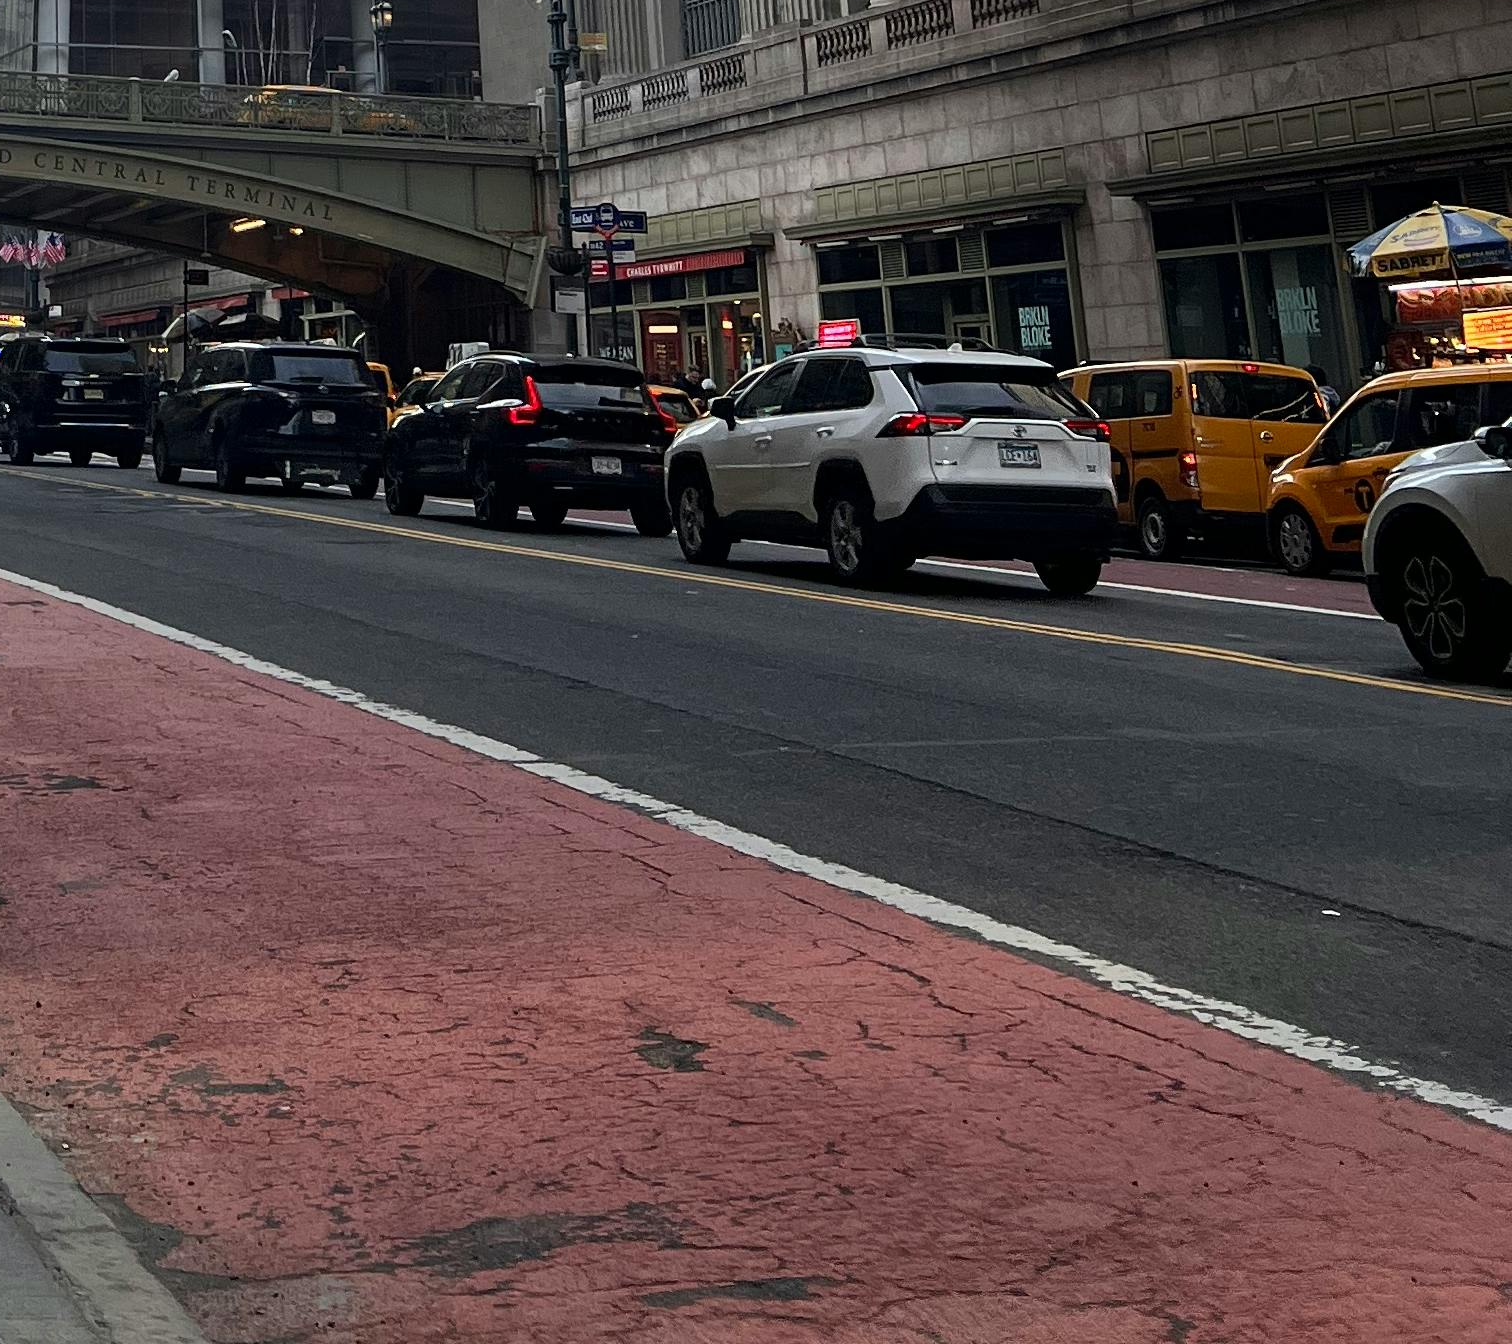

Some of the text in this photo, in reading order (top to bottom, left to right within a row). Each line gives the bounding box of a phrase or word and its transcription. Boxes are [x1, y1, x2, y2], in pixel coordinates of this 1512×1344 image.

[34, 153, 166, 186] CENTRAL
[188, 175, 334, 221] TERMINAL
[1377, 253, 1444, 273] SABRETT
[1275, 286, 1318, 311] BRKLN
[1018, 305, 1050, 327] BRKLN
[1278, 309, 1321, 335] BLOKE
[1021, 326, 1052, 348] BLOKE
